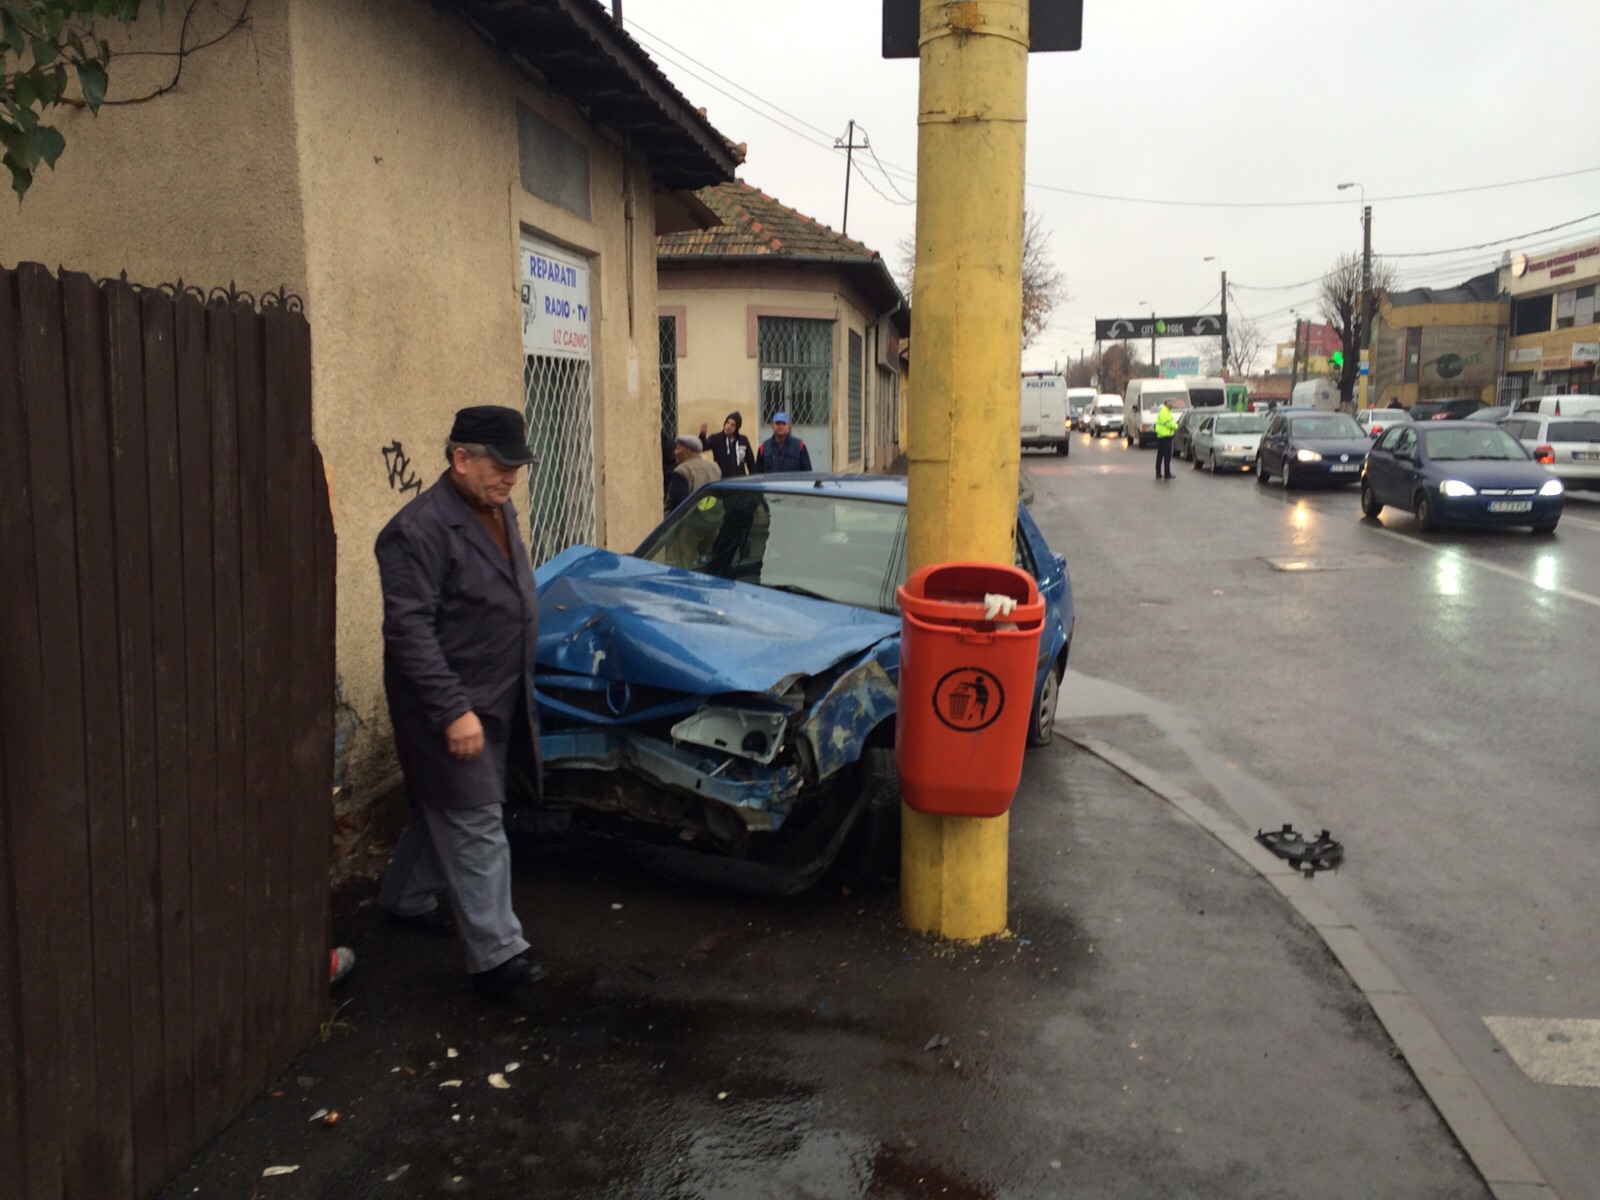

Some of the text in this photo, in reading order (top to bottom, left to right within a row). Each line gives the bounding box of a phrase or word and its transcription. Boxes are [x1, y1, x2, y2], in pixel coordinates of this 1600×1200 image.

[530, 256, 576, 287] REPARATII
[545, 296, 570, 318] RADIO
[578, 304, 587, 322] TV
[1141, 323, 1184, 334] CITY PARK
